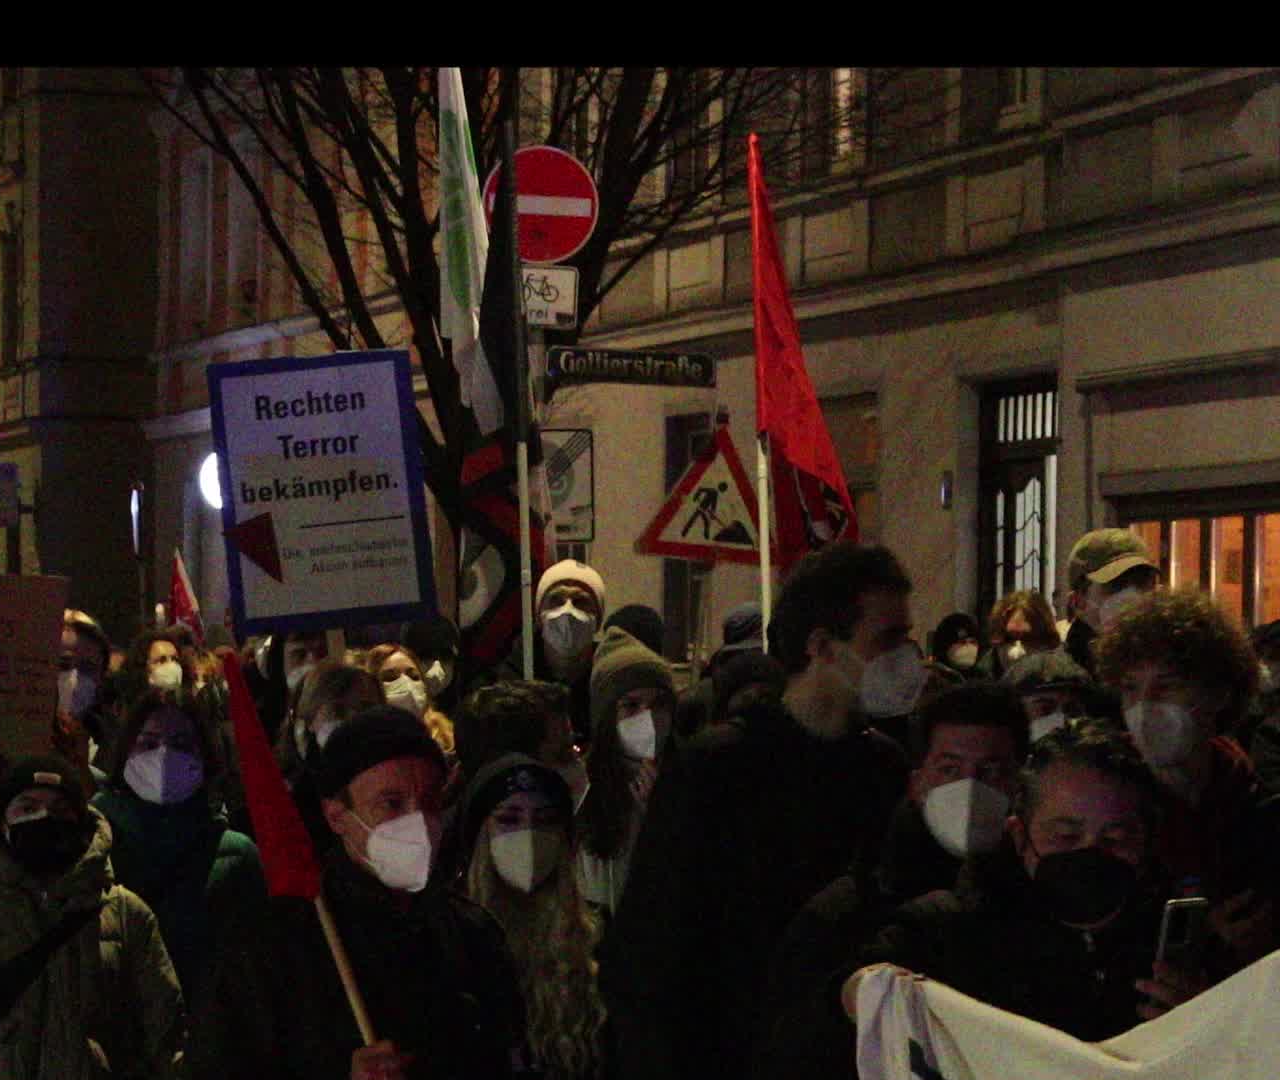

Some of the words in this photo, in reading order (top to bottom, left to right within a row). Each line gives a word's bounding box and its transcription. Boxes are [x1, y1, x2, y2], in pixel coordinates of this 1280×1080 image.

[254, 390, 366, 421] Rechten
[277, 434, 359, 460] Terror
[239, 469, 399, 504] bekämpfen.
